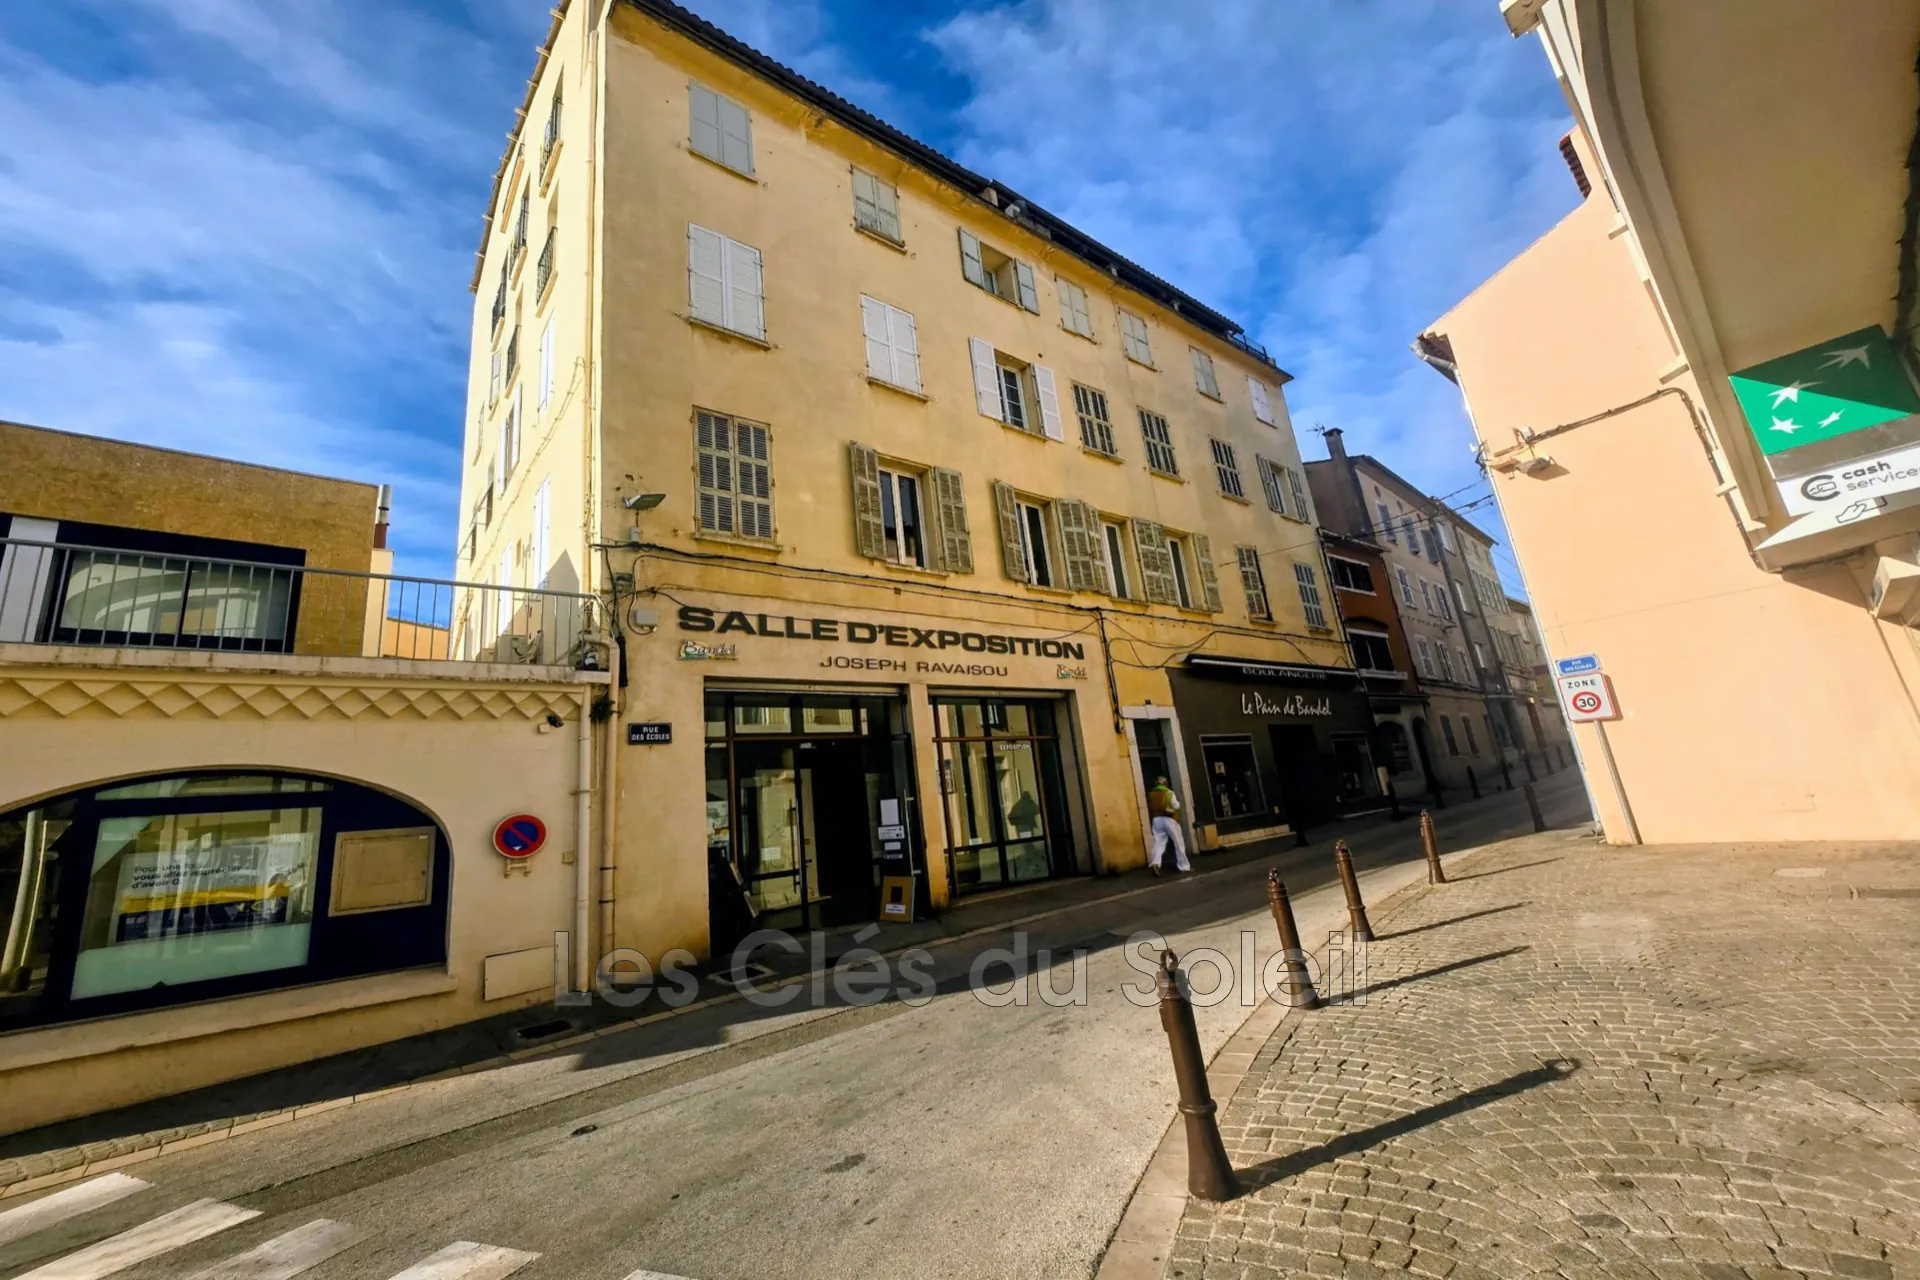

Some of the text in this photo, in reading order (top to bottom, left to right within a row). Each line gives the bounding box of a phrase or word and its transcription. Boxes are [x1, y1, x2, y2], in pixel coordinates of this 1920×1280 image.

[1841, 461, 1891, 480] cash
[1846, 466, 1920, 492] service
[679, 606, 1085, 660] SALLE D'EXPOSITION
[820, 656, 1008, 677] JOSEPH RAVAISOU
[1567, 679, 1597, 689] ZONE
[1241, 691, 1332, 716] Le Pain de Bandol
[1578, 697, 1596, 708] 30
